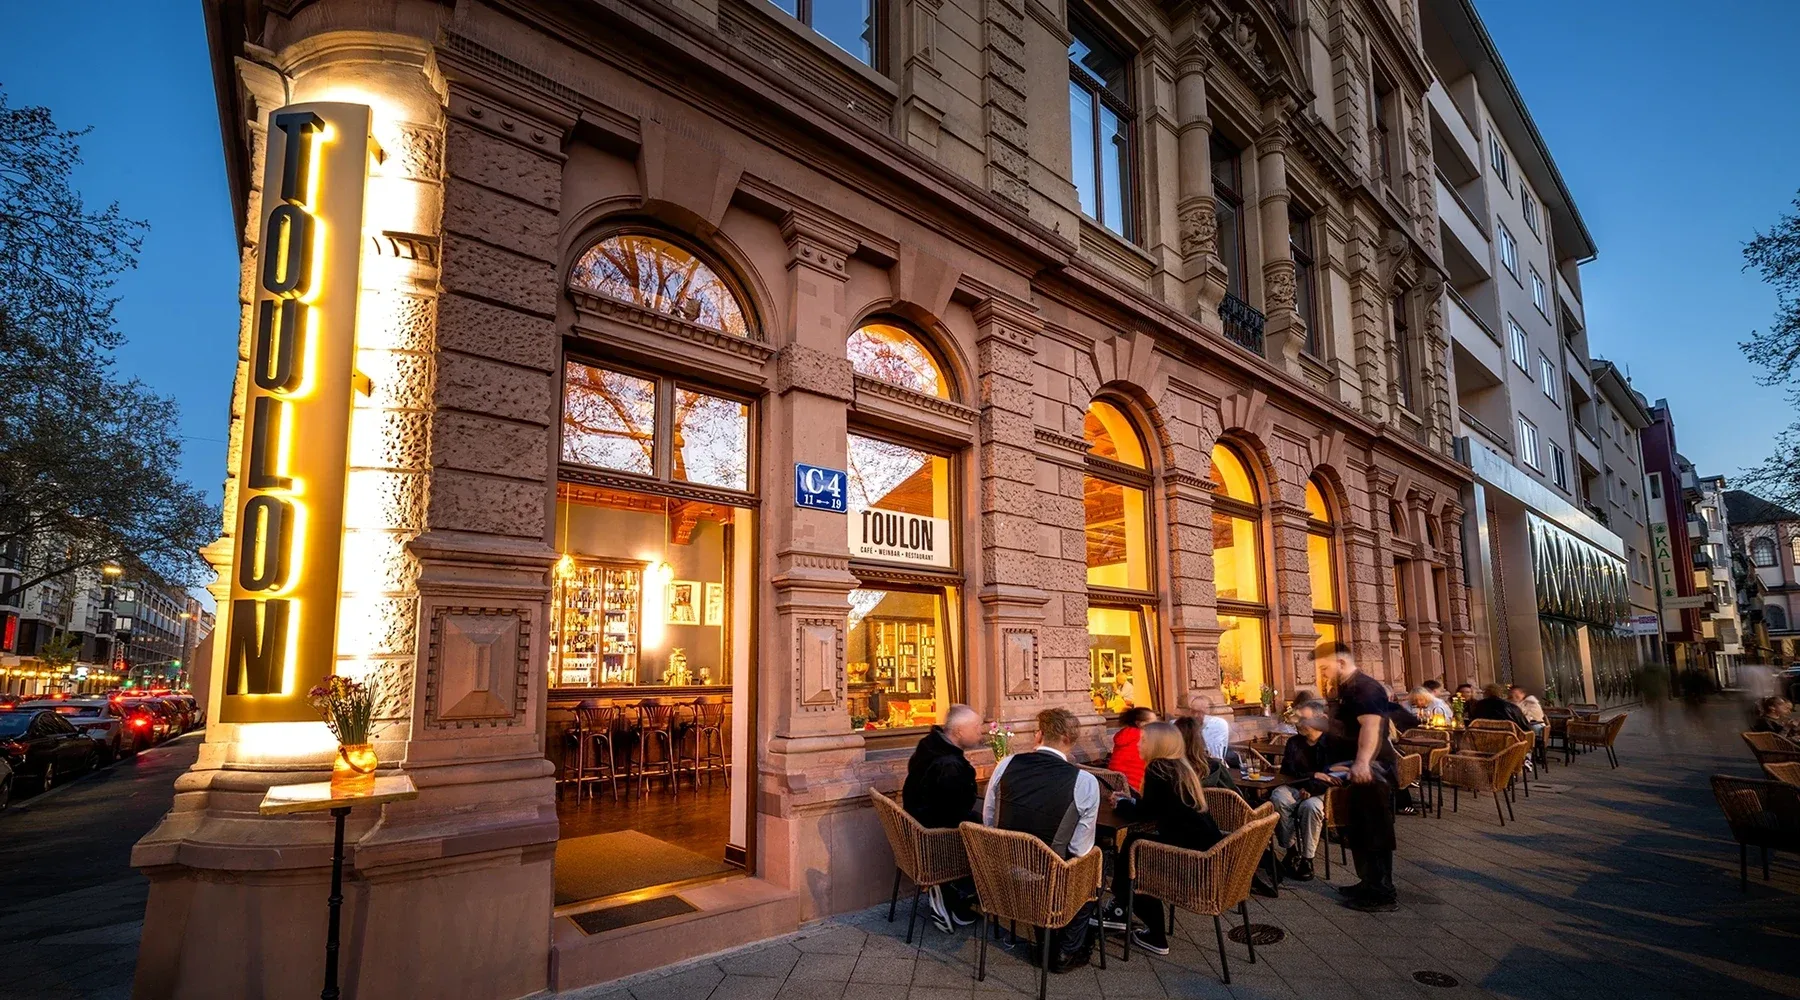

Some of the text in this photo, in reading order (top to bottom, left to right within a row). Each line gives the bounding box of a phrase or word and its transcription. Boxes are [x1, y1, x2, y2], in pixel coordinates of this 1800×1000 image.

[227, 112, 325, 696] TOULON
[805, 468, 841, 498] C 4
[804, 494, 842, 509] 11 19
[861, 510, 934, 551] TOULON
[860, 546, 934, 561] CAFÉ WEINBAR RESTAURANT
[1655, 536, 1671, 585] KALI
